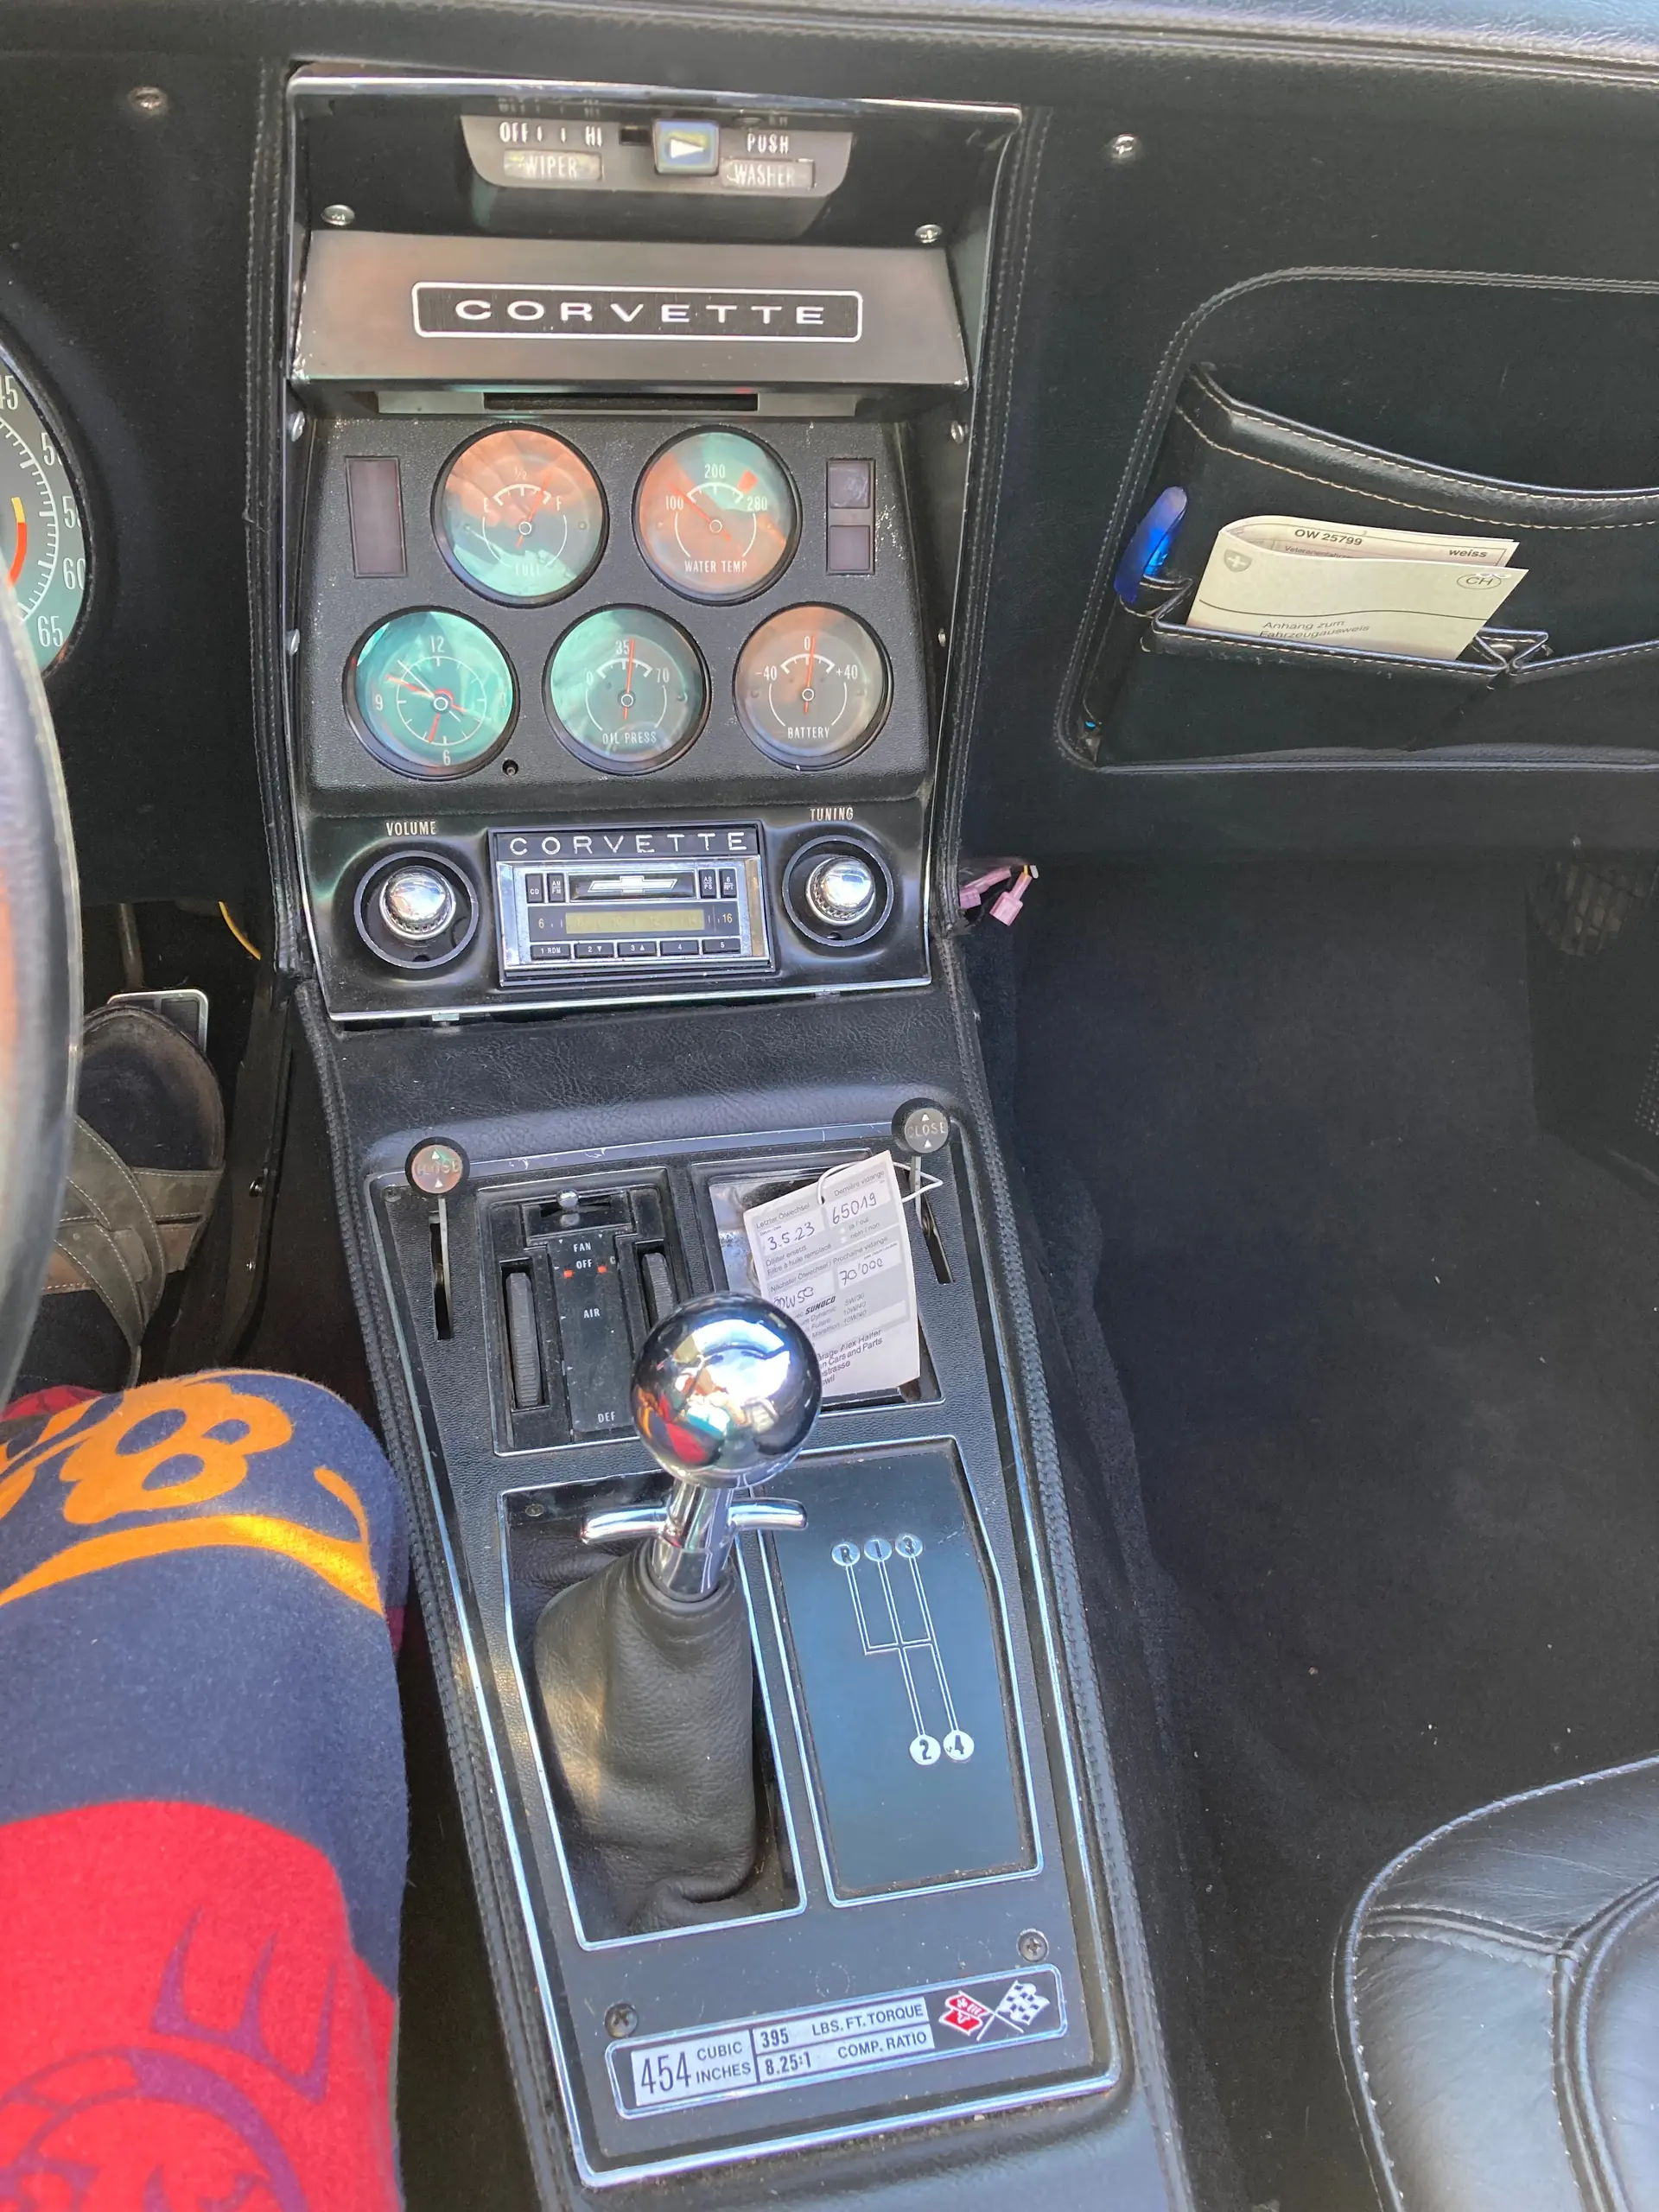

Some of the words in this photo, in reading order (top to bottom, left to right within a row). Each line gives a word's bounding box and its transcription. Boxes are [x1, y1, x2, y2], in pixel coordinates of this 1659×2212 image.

[499, 122, 528, 143] OFF
[585, 126, 602, 147] HI
[747, 133, 789, 154] PUSH
[524, 158, 578, 179] WIPER
[734, 162, 796, 188] WASHER
[454, 300, 825, 326] CORVETTE
[41, 432, 63, 467] 5
[704, 463, 726, 479] 200
[483, 497, 490, 513] E
[556, 495, 563, 512] F
[665, 495, 684, 511] 100
[747, 496, 768, 511] 280
[1294, 529, 1320, 539] OW
[1321, 532, 1363, 546] 25799
[1449, 549, 1488, 558] weiss
[684, 560, 716, 573] WATER
[721, 560, 747, 573] TEMP
[1465, 576, 1494, 586] CH
[37, 615, 64, 647] 65
[1259, 625, 1371, 639] Fahrzeugausweis
[1262, 621, 1314, 632] Anhang
[1317, 620, 1345, 629] zum
[430, 635, 445, 653] 12
[615, 639, 630, 655] 35
[804, 636, 811, 651] 0
[586, 671, 594, 686] 0
[657, 668, 670, 683] 70
[836, 664, 858, 680] +40
[374, 694, 384, 711] 9
[602, 733, 620, 745] OIL
[625, 731, 657, 744] PRESS
[787, 726, 830, 740] BATTERY
[442, 749, 451, 766] 6
[810, 806, 854, 822] TUNING
[385, 821, 437, 836] VOLUME
[509, 831, 747, 856] CORVETTE
[537, 918, 544, 929] 6
[721, 912, 734, 924] 16
[907, 1122, 947, 1138] CLOSE
[832, 1192, 877, 1225] 65019
[573, 1243, 591, 1253] FAN
[575, 1259, 593, 1269] OFF
[583, 1307, 601, 1319] AIR
[804, 1295, 836, 1316] SUNOCO
[828, 1353, 847, 1366] Cars
[847, 1346, 861, 1358] and
[863, 1337, 883, 1351] Parts
[597, 1411, 616, 1423] DEF
[811, 2019, 844, 2037] LBS.
[845, 2015, 867, 2031] FT.
[867, 2004, 925, 2026] TORQUE
[760, 2027, 790, 2049] 395
[837, 2040, 884, 2060] COMP.
[886, 2031, 927, 2050] RATIO
[696, 2041, 743, 2062] CUBIC
[765, 2050, 812, 2075] 8.25:1
[640, 2050, 692, 2094] 454
[696, 2062, 752, 2084] INCHES
